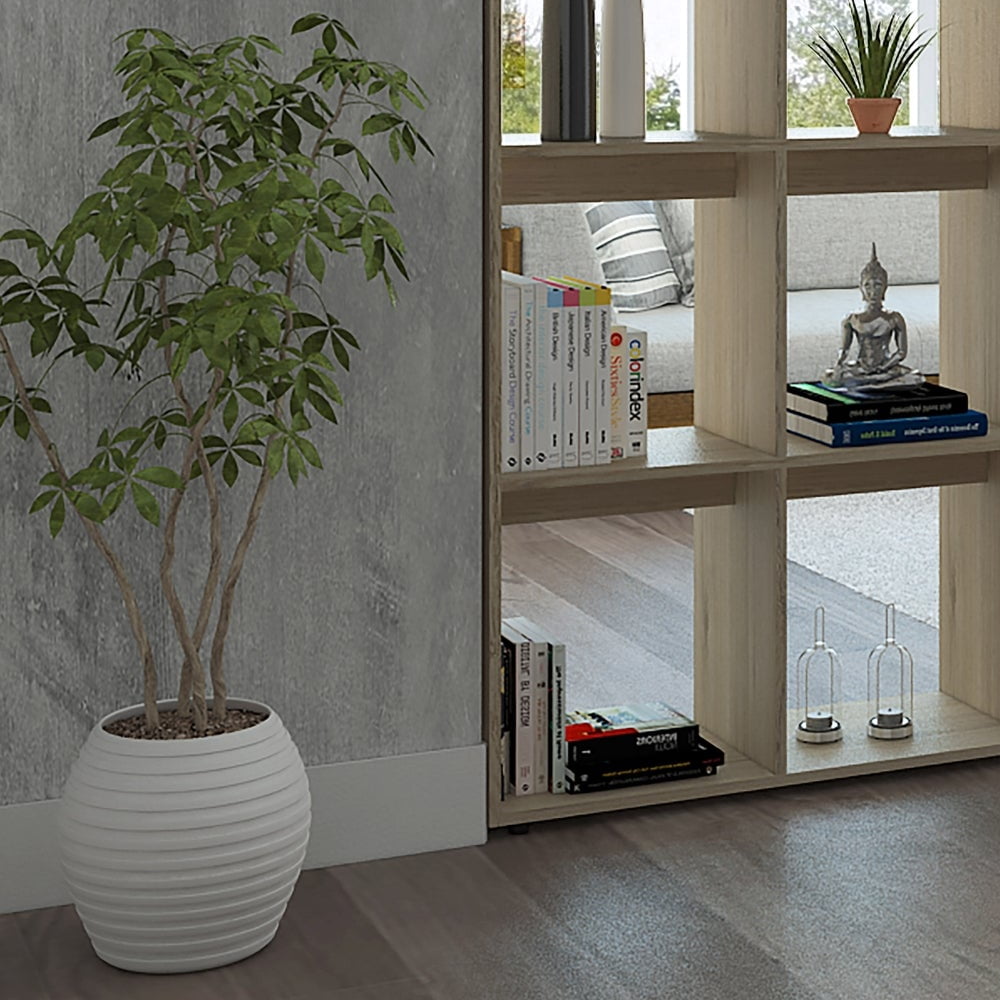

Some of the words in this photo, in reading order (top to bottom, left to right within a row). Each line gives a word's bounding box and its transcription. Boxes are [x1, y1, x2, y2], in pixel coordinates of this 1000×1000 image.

[509, 311, 517, 326] The
[567, 312, 576, 348] Japanese
[600, 310, 608, 344] American
[508, 328, 518, 379] Storyboard
[550, 336, 559, 360] Design
[582, 332, 592, 357] Design
[599, 344, 608, 368] Design
[566, 348, 575, 372] Design
[507, 380, 517, 409] Design
[629, 339, 644, 422] colorindex
[508, 411, 516, 444] Course
